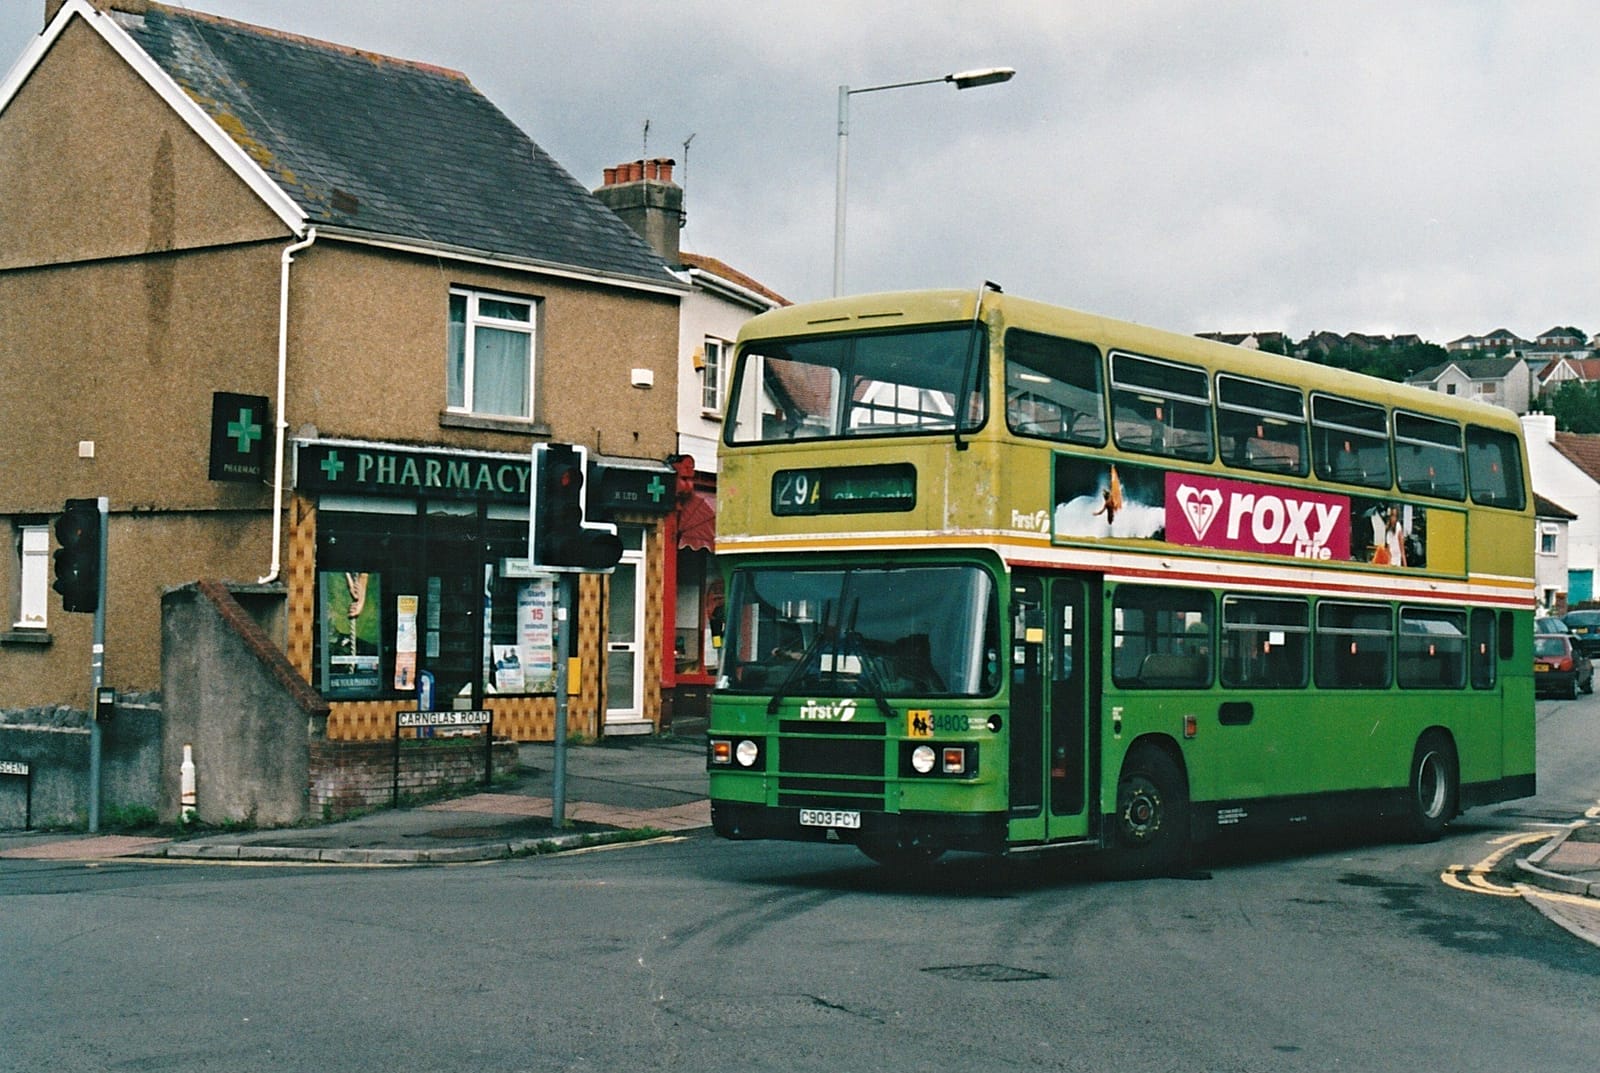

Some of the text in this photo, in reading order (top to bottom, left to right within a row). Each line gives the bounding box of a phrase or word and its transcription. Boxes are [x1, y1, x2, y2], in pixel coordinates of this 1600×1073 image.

[356, 453, 530, 493] PHARMACY
[1011, 509, 1035, 529] First
[1226, 492, 1343, 546] roxy
[1294, 539, 1332, 560] Life
[531, 608, 544, 620] 15
[399, 711, 488, 725] CARNGLAS ROAD
[928, 714, 970, 732] 34803
[802, 810, 860, 827] C903 FCY
